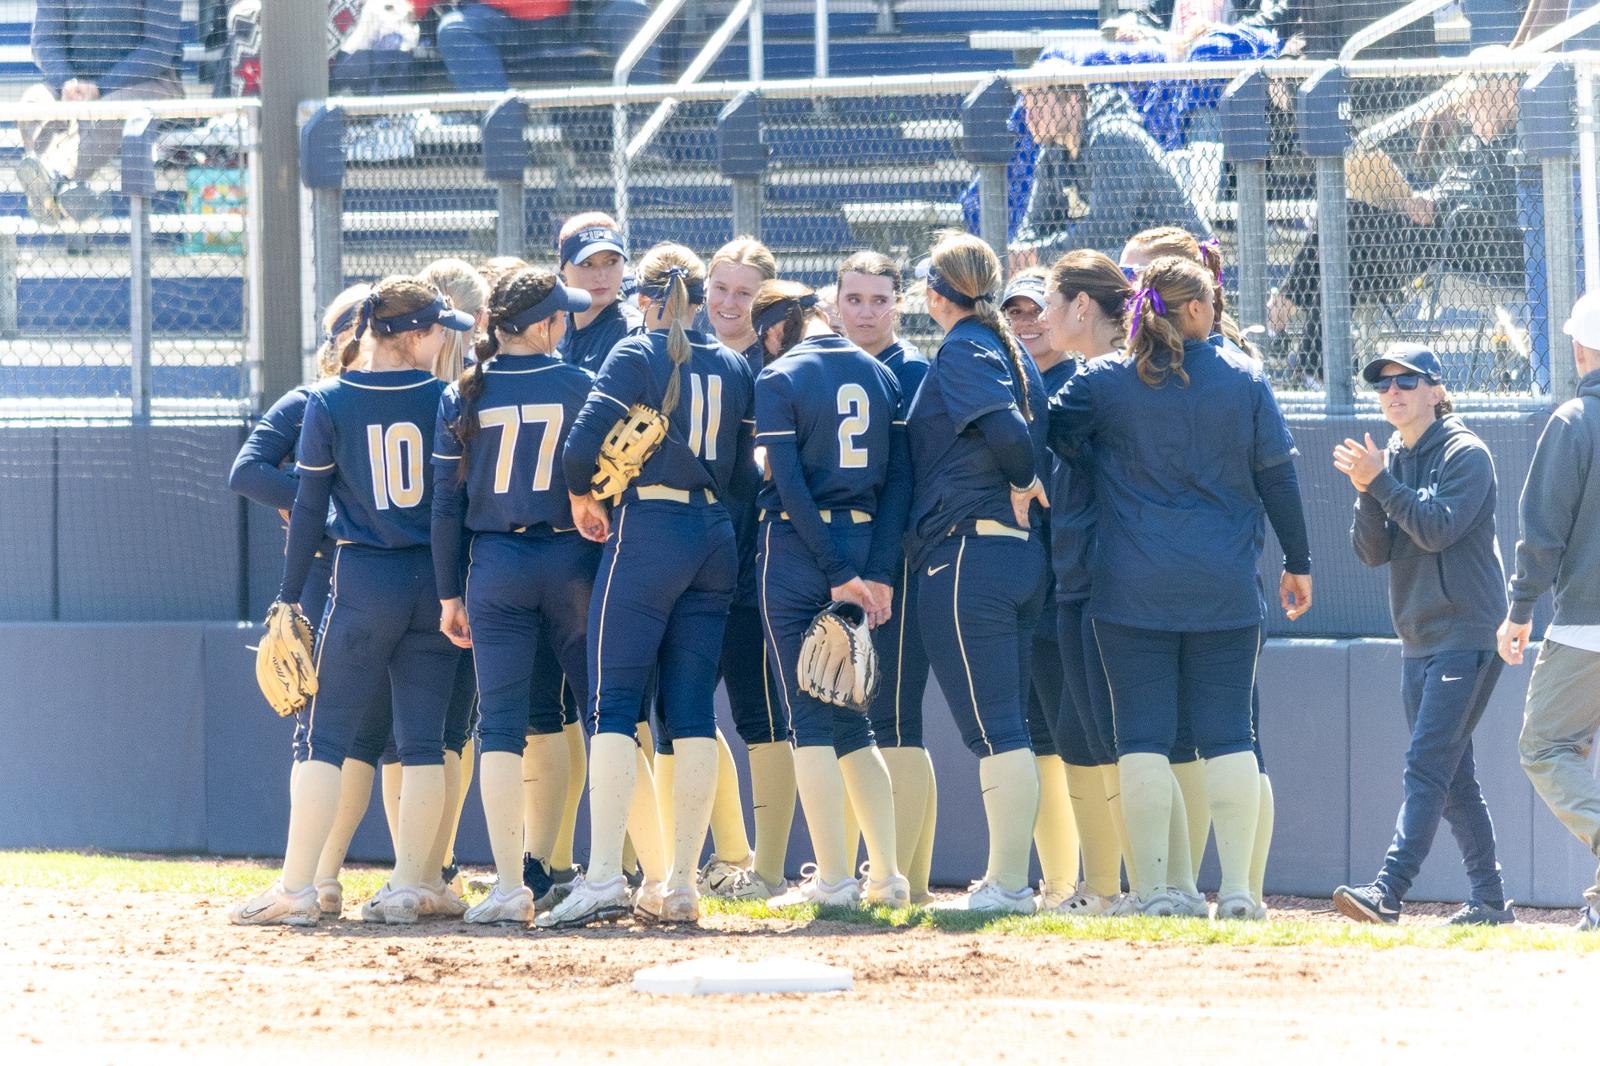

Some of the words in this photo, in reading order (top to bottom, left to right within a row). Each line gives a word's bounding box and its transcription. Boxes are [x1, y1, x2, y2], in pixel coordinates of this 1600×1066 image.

[478, 403, 564, 494] 77
[688, 373, 722, 461] 11
[836, 383, 870, 468] 2
[366, 421, 424, 510] 10
